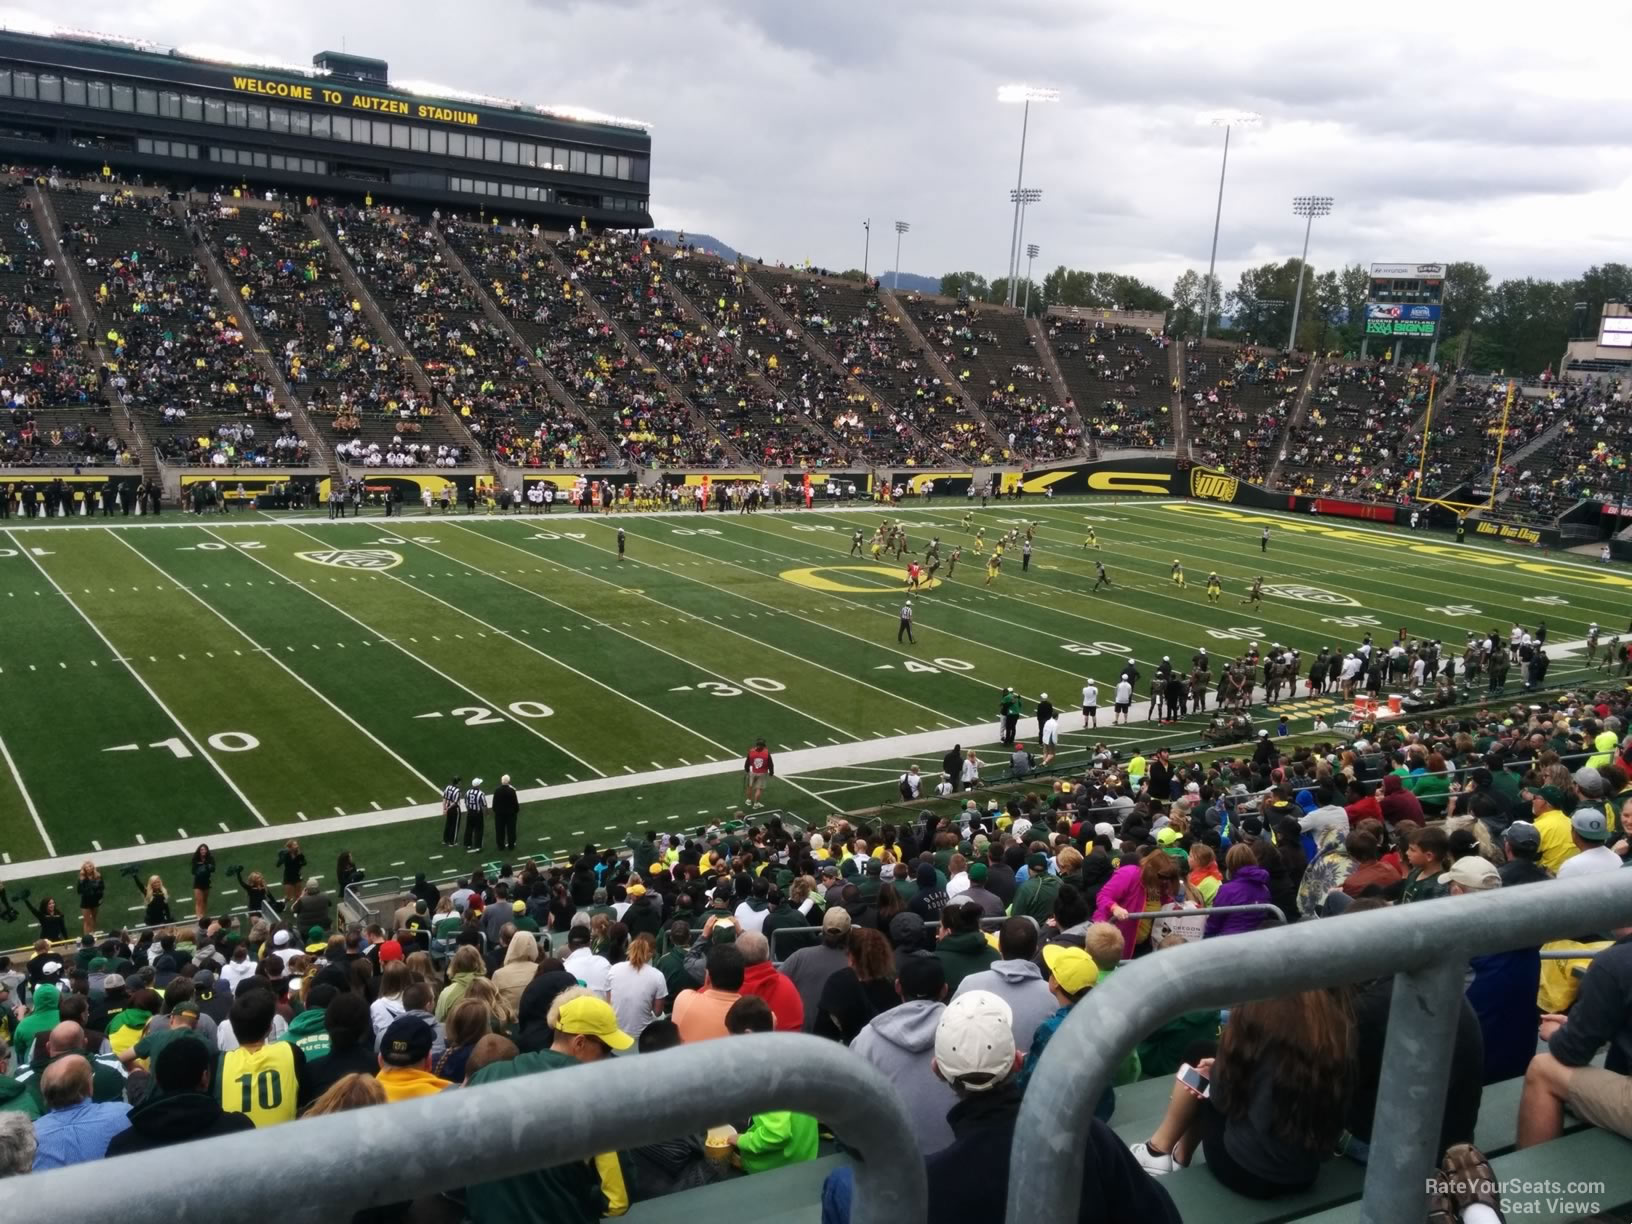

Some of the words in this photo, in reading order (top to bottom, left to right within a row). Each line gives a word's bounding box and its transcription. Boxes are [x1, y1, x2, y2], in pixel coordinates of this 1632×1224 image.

[232, 76, 313, 101] WELCOME
[322, 89, 343, 105] TO
[352, 95, 409, 115] AUTZEN
[418, 105, 479, 125] STADIUM
[1476, 521, 1499, 535] Win
[1500, 524, 1519, 538] The
[1518, 527, 1541, 544] Day
[1161, 504, 1632, 593] OREGO
[1204, 627, 1267, 640] 40
[1060, 640, 1133, 656] 50
[903, 657, 976, 675] 40
[694, 676, 788, 698] 30
[450, 700, 556, 726] 20
[148, 731, 261, 758] 10
[923, 890, 949, 904] DEATH
[300, 1043, 330, 1053] UCK
[235, 1068, 283, 1113] 10
